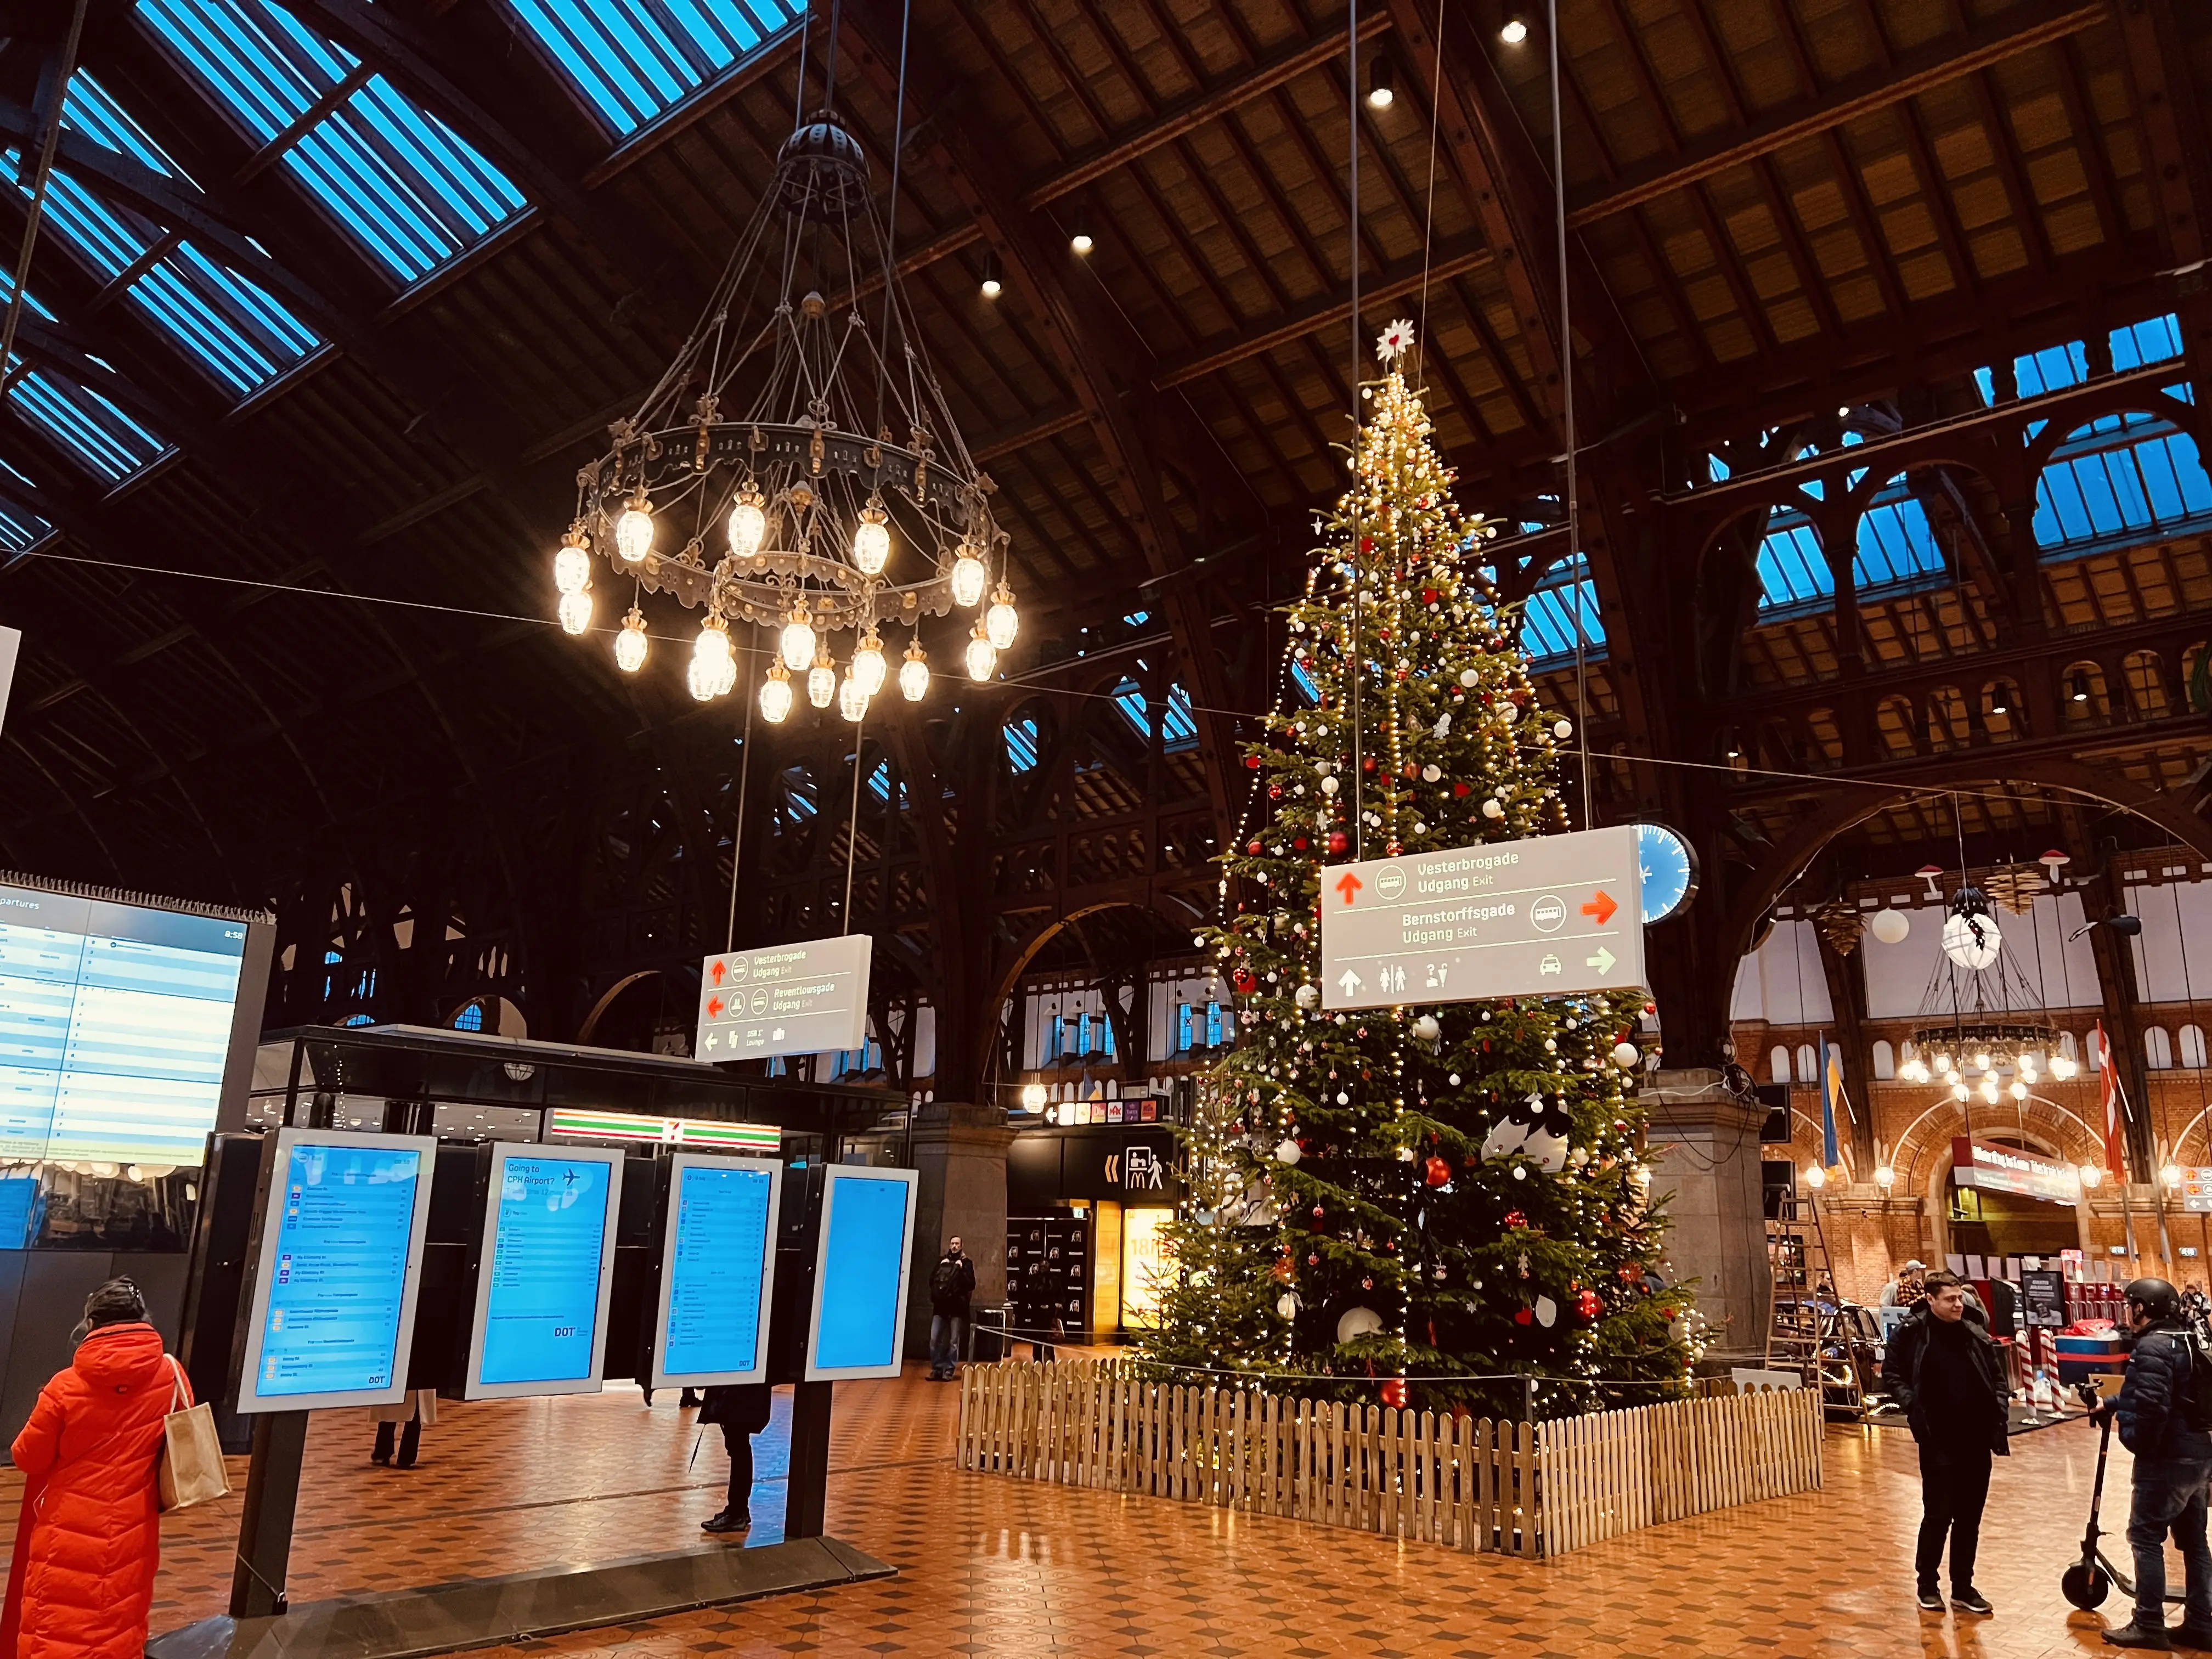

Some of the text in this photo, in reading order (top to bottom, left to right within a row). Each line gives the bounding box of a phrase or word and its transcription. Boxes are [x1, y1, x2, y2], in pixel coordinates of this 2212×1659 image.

[1418, 852, 1519, 876] Vesterbrogade
[1418, 874, 1493, 893] Udgang Exit
[1403, 903, 1515, 927] Bernstorffsgade
[1403, 927, 1477, 944] Udgang Exit
[754, 950, 806, 966] Vesterbrogade
[753, 966, 779, 978] Udgang
[774, 983, 835, 998] Reventlowsgade
[773, 999, 800, 1012] Udgang
[509, 1164, 530, 1175] Going
[507, 1175, 555, 1185] CPH Airport?
[555, 1327, 575, 1337] DOT
[369, 1376, 385, 1384] DOT
